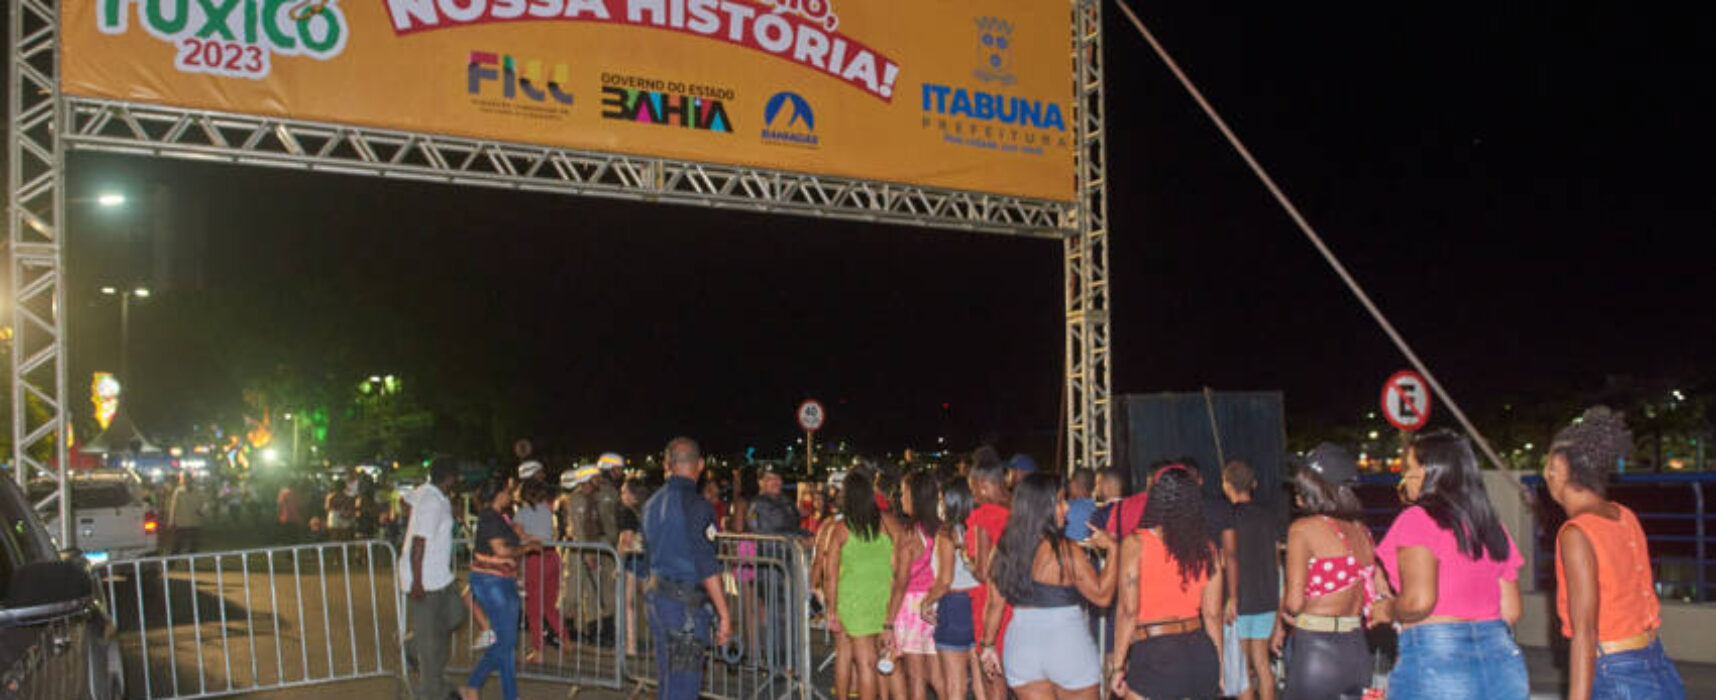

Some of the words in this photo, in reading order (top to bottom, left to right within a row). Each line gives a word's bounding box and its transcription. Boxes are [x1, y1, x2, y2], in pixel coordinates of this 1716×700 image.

[388, 0, 611, 30] NOSSA
[183, 38, 262, 71] 2023
[601, 72, 664, 91] GOVERNO
[668, 82, 685, 93] DO
[689, 84, 735, 99] ESTADO
[601, 85, 734, 132] BAHIA
[922, 83, 1065, 131] ITABUNA
[922, 116, 1066, 146] PREFEITURA
[804, 406, 818, 416] 40
[1399, 384, 1418, 418] E
